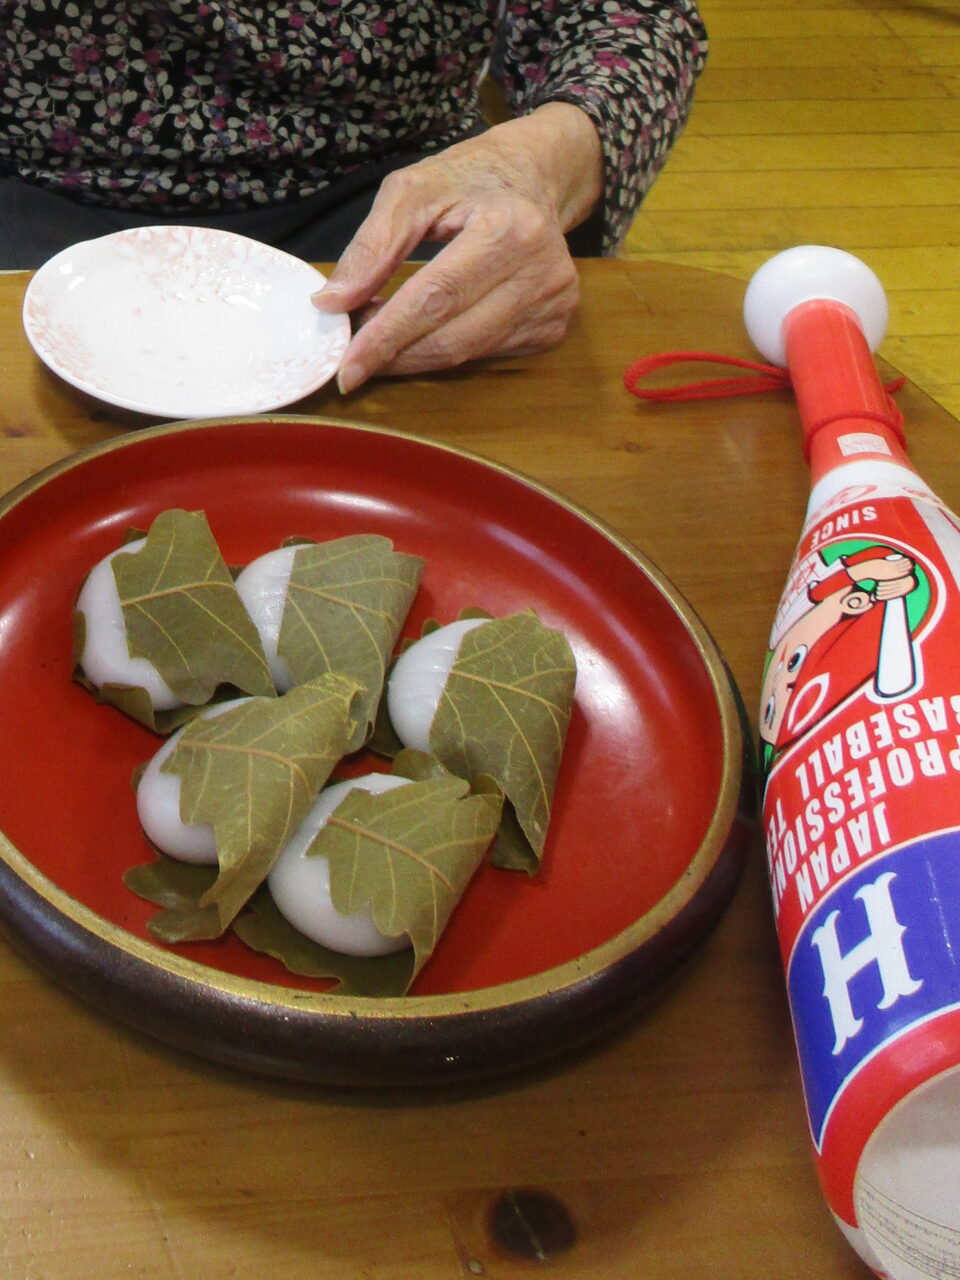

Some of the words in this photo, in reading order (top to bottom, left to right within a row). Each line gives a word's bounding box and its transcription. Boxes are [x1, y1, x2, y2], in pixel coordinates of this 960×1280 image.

[810, 506, 878, 549] SINCE
[772, 734, 960, 917] ROFESSION
[796, 801, 892, 912] JAPAN
[811, 871, 924, 1057] H
